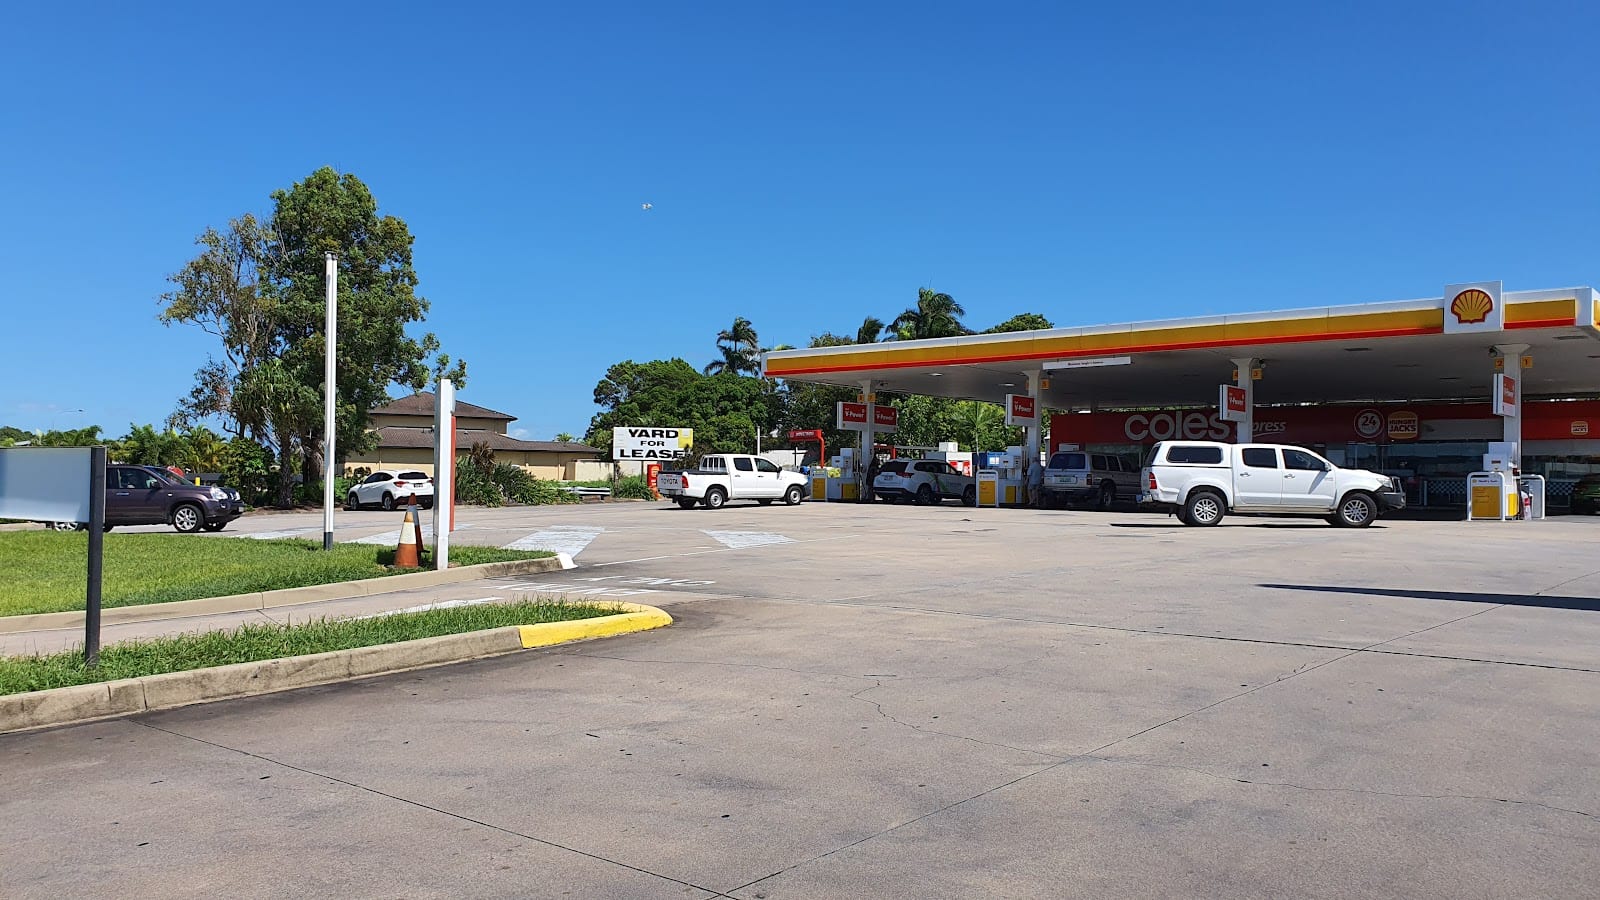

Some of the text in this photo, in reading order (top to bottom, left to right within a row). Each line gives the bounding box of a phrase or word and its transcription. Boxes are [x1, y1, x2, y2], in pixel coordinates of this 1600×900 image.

[1125, 411, 1230, 441] coles
[1362, 416, 1377, 426] 24
[628, 429, 679, 439] YARD
